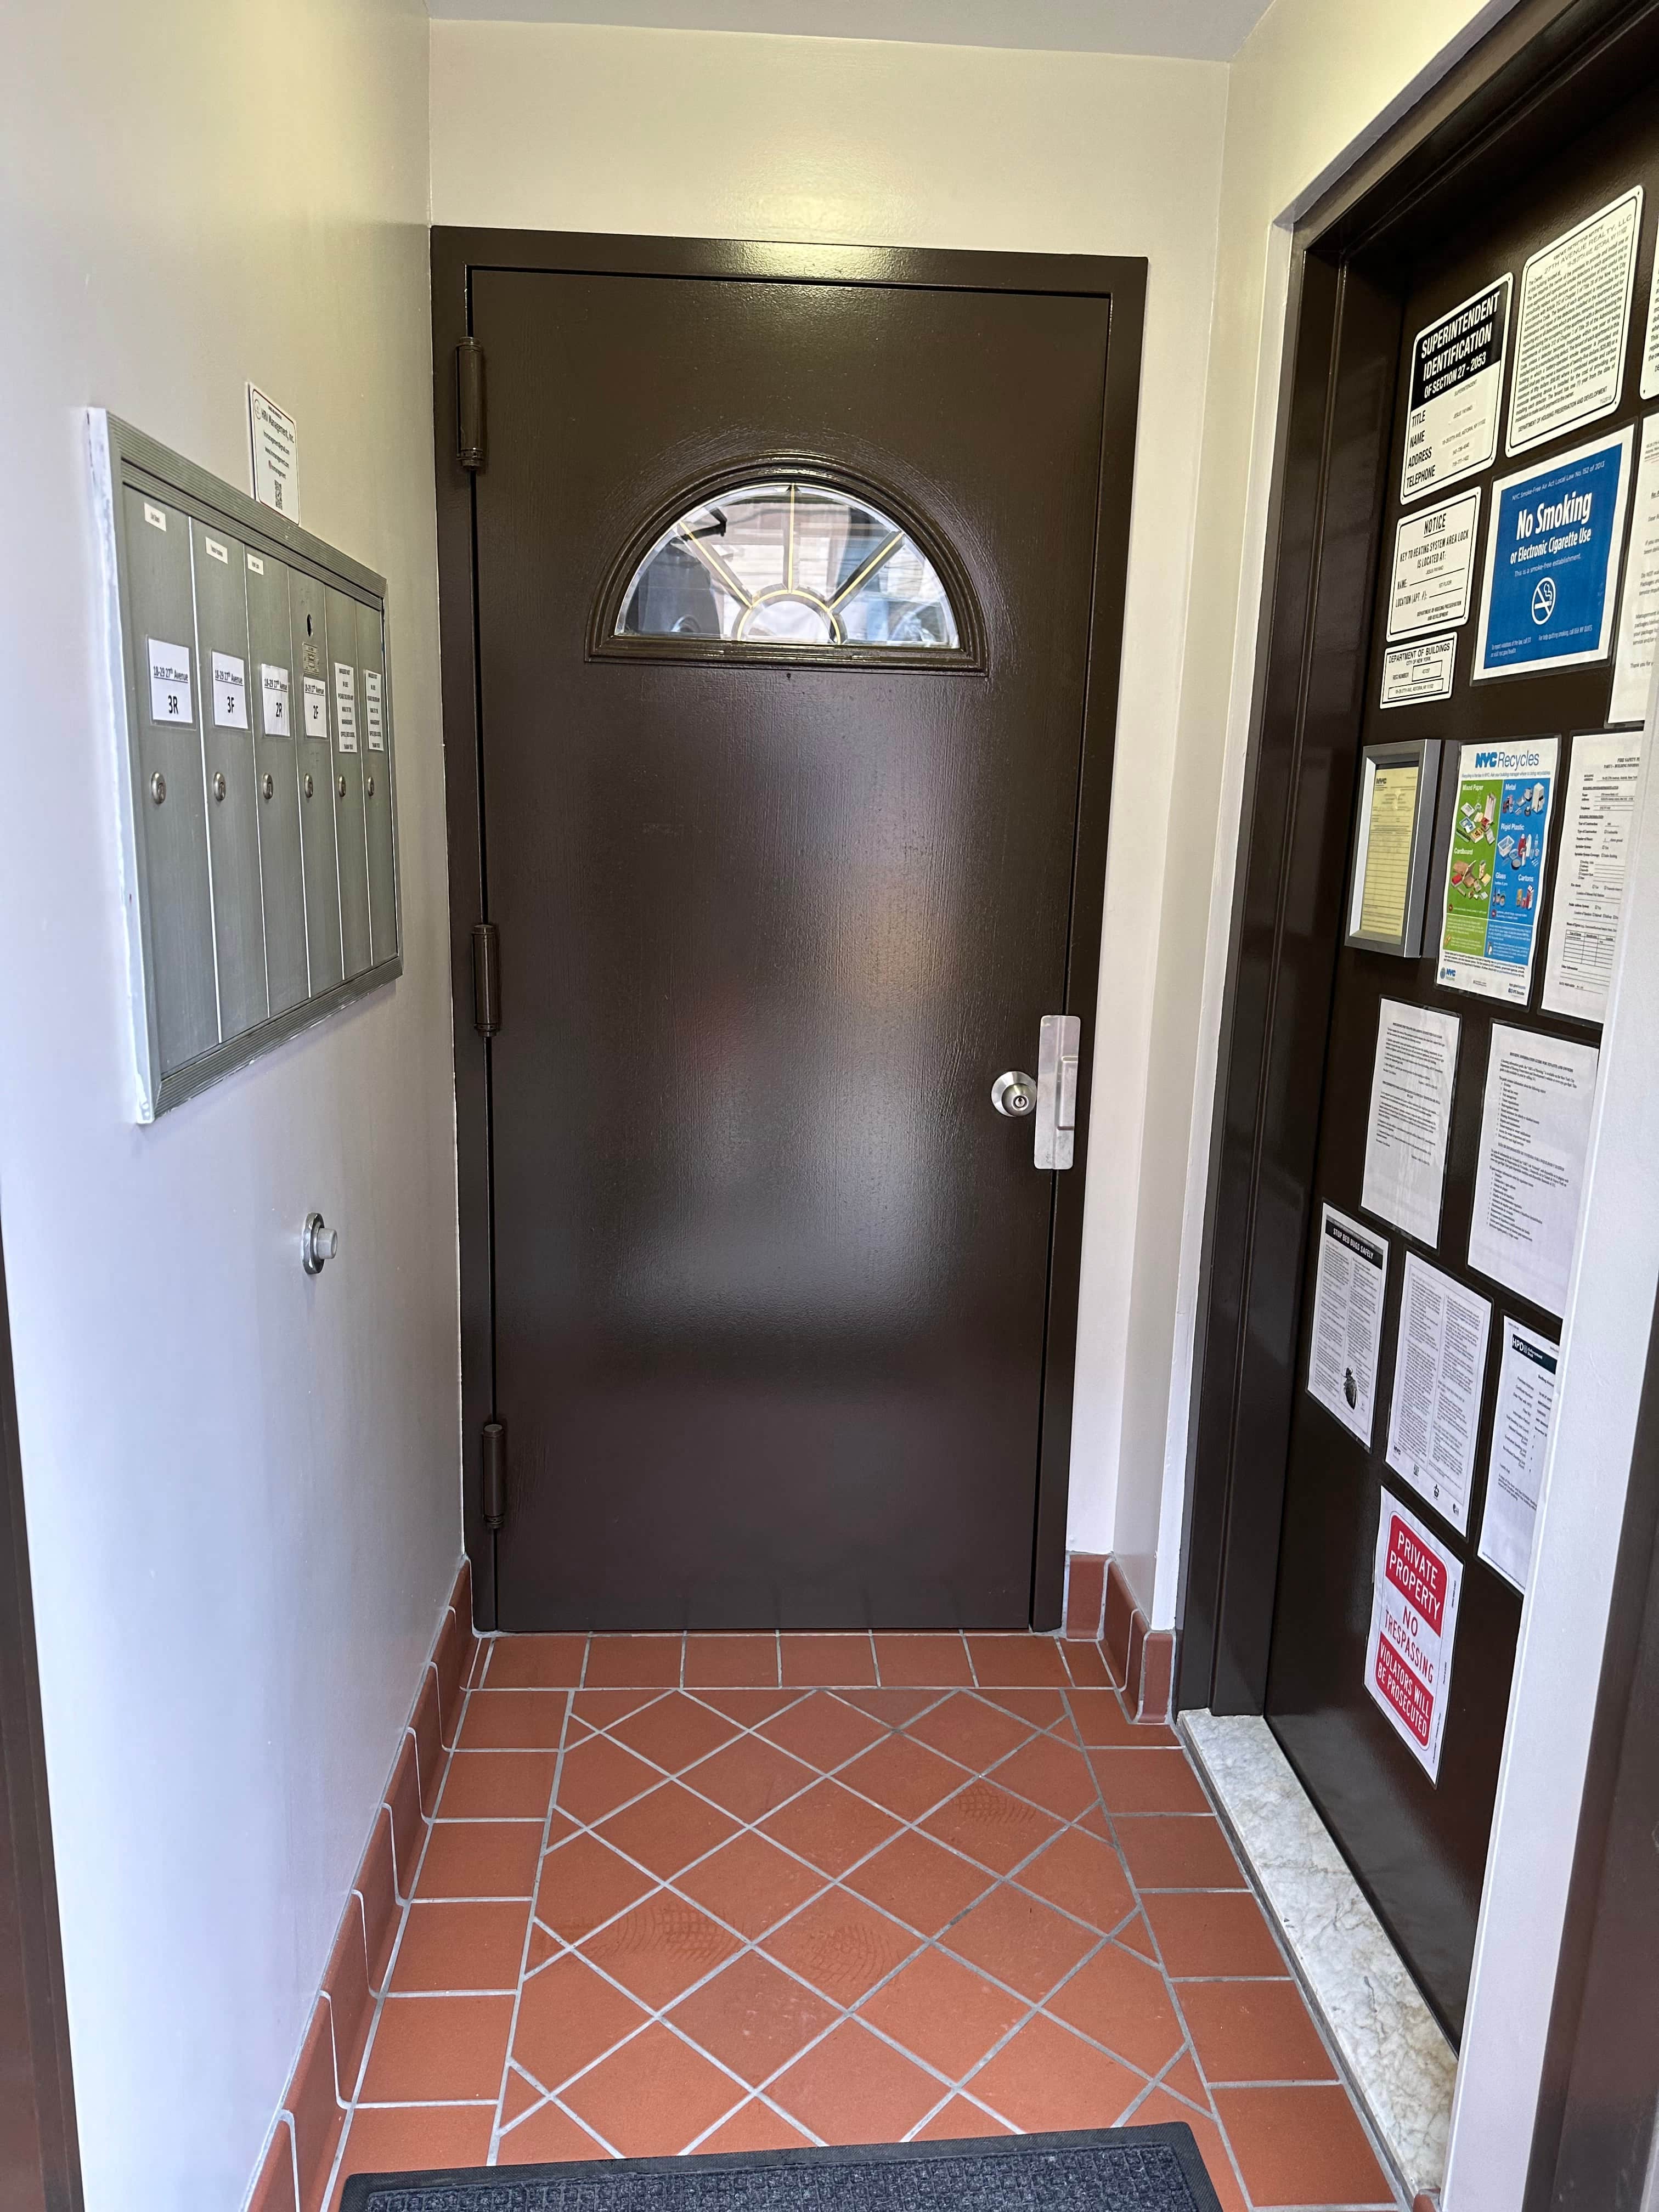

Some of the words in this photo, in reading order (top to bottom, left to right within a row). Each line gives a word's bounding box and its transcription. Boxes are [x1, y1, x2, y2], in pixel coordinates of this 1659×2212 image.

[1544, 261, 1559, 274] 27TH
[1561, 243, 1586, 263] AVENUE
[1618, 214, 1632, 227] LLC
[1421, 291, 1500, 358] SUPERINTENDENT
[1423, 322, 1492, 381] IDENTIFICATION
[1424, 383, 1432, 398] OF
[1432, 368, 1457, 393] SECTION
[1458, 363, 1466, 379] 27
[1470, 352, 1486, 371] 2053
[1412, 410, 1426, 427] TITLE
[1410, 430, 1425, 448] NAME
[1408, 447, 1432, 469] ADDRESS
[1407, 465, 1435, 488] TELEPHONE
[1520, 486, 1541, 498] Smoke-Free
[1555, 476, 1565, 484] Local
[1595, 461, 1605, 470] 2013
[1424, 513, 1446, 534] NOTICE
[1516, 509, 1533, 540] No
[1535, 491, 1592, 534] Smoking
[1408, 550, 1413, 559] TO
[1413, 544, 1429, 557] HEATING
[1430, 538, 1446, 551] SYSTEM
[1446, 534, 1457, 546] AREA
[1458, 529, 1469, 541] LOCK
[1510, 552, 1517, 564] or
[1518, 540, 1548, 562] Electronic
[1549, 531, 1578, 554] Cigarette
[1579, 527, 1591, 544] Use
[1417, 559, 1421, 568] IS
[1421, 553, 1439, 567] LOCATED
[1530, 562, 1552, 573] smoke-free
[1553, 553, 1581, 566] establishment.
[1396, 595, 1411, 607] LOCATION
[1389, 650, 1417, 663] DEPARTMENT
[1418, 648, 1424, 657] OF
[1425, 642, 1450, 656] BUILDINGS
[153, 665, 165, 677] 18-29
[174, 669, 188, 681] Avenue
[231, 673, 242, 685] Avenue
[168, 695, 179, 715] 3R
[227, 696, 234, 713] 3F
[276, 702, 282, 718] 2R
[313, 705, 319, 719] 2F
[1475, 752, 1497, 768] NYC
[1498, 750, 1539, 771] Recycles
[1518, 874, 1534, 882] Cartons
[1333, 1228, 1342, 1238] STOP
[1350, 1239, 1360, 1251] BUGS
[1360, 1245, 1373, 1259] SAFELY
[1513, 1337, 1523, 1352] HPD
[1398, 1531, 1437, 1589] PRIVATE
[1390, 1550, 1440, 1620] PROPERTY
[1403, 1606, 1418, 1637] NO
[1385, 1609, 1434, 1684] TRESPASSING
[1380, 1642, 1413, 1696] VIOLATORS
[1414, 1685, 1429, 1719] WILL
[1378, 1662, 1386, 1684] BE
[1387, 1674, 1427, 1737] PROSECUTED
